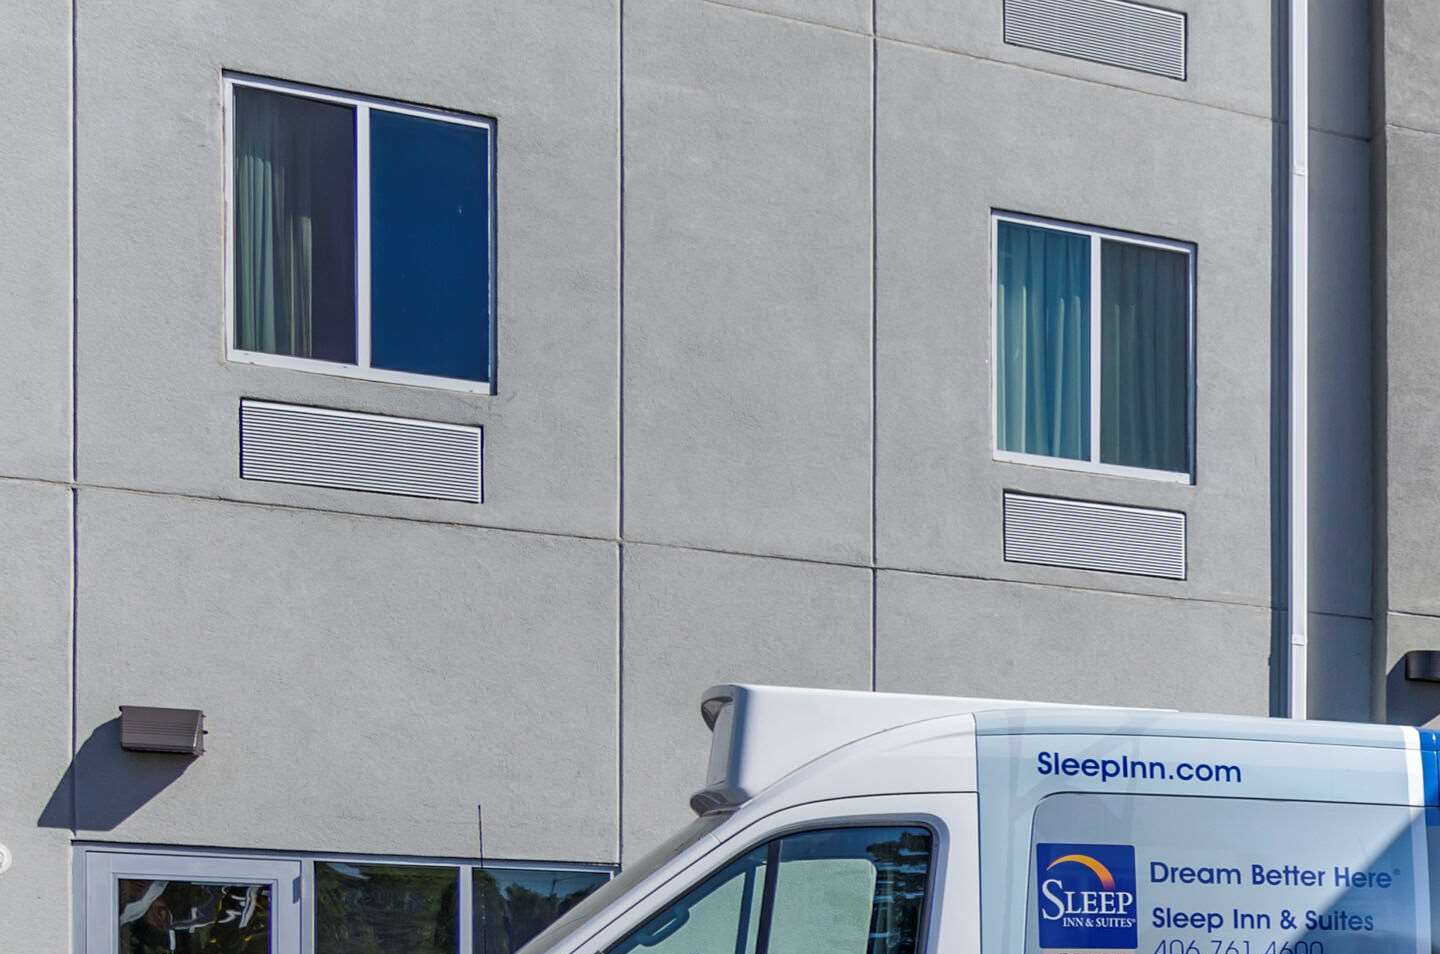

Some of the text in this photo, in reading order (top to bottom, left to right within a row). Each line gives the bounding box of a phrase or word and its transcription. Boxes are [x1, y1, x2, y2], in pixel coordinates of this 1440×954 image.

[1037, 751, 1242, 783] SleepInn.com
[1150, 861, 1242, 885] Dream
[1252, 863, 1326, 888] Better
[1041, 878, 1134, 920] SLEEP
[1062, 917, 1083, 928] INN
[1084, 917, 1094, 928] &
[1151, 907, 1374, 934] Sleep Inn & Suites
